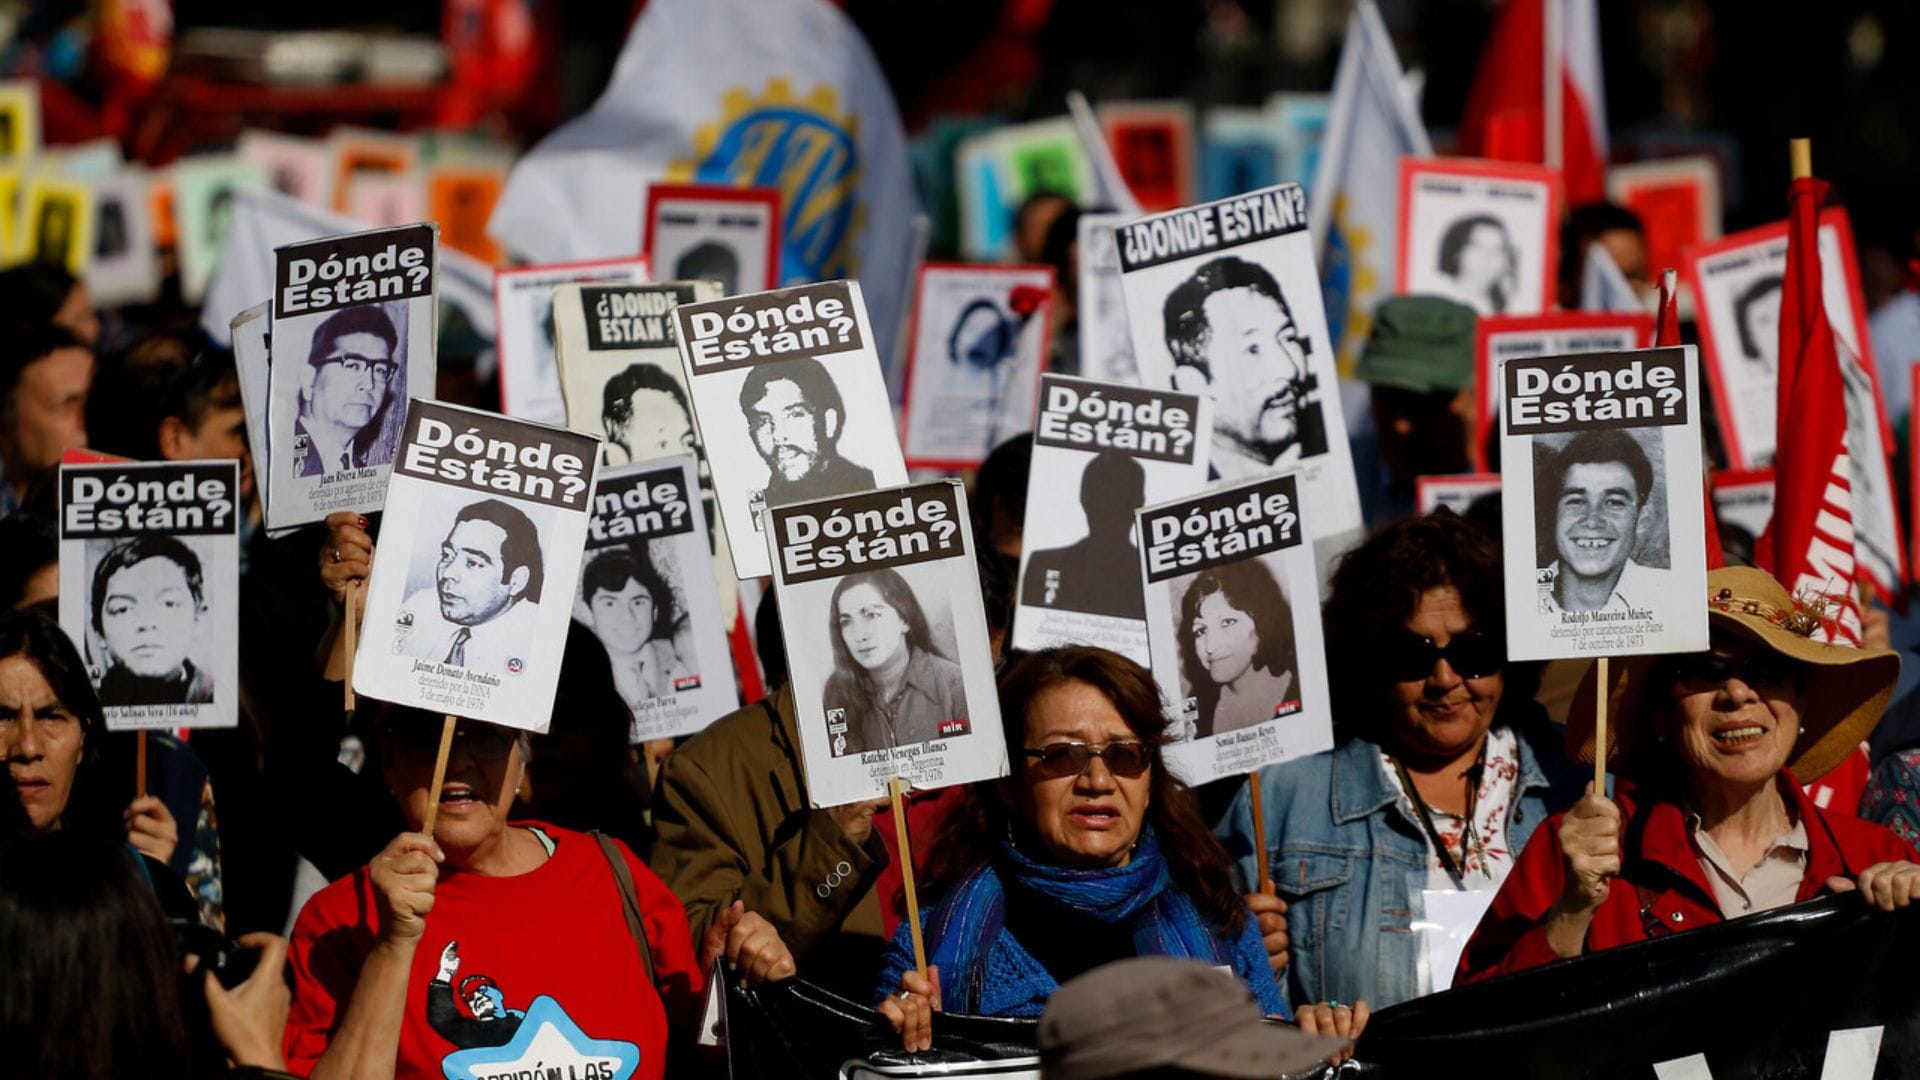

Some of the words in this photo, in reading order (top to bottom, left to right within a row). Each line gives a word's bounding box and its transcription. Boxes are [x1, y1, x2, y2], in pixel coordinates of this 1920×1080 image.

[1125, 207, 1218, 264] ¿DONDE
[1219, 187, 1305, 241] ESTAN?
[289, 244, 424, 285] Dónde
[283, 265, 429, 312] Están?
[690, 296, 844, 339] Dónde
[691, 317, 853, 366] Están?
[1516, 361, 1676, 396] Dónde
[1048, 385, 1189, 429] Dónde
[1511, 387, 1682, 426] Están?
[416, 417, 583, 475] Dónde
[1039, 411, 1193, 455] Están?
[73, 473, 226, 504] Dónde
[404, 443, 586, 503] Están?
[66, 500, 232, 532] Están?
[595, 481, 678, 514] nde
[590, 500, 687, 541] tán?
[785, 497, 947, 544] Dónde
[1151, 493, 1289, 545] Dónde
[783, 520, 956, 575] Están?
[1149, 512, 1296, 573] Están?
[1550, 624, 1581, 637] detenido
[1582, 627, 1593, 639] por
[1595, 621, 1633, 634] carabineros
[1634, 621, 1644, 632] de
[1561, 610, 1589, 626] Rodolfo
[1590, 609, 1625, 621] Maureira
[1627, 607, 1653, 620] Muñoz
[1577, 636, 1586, 649] de
[1588, 637, 1614, 648] octubre
[1615, 635, 1624, 647] de
[418, 673, 448, 689] detenido
[449, 683, 461, 695] por
[425, 688, 435, 700] de
[455, 694, 465, 705] de
[868, 762, 898, 776] detenido
